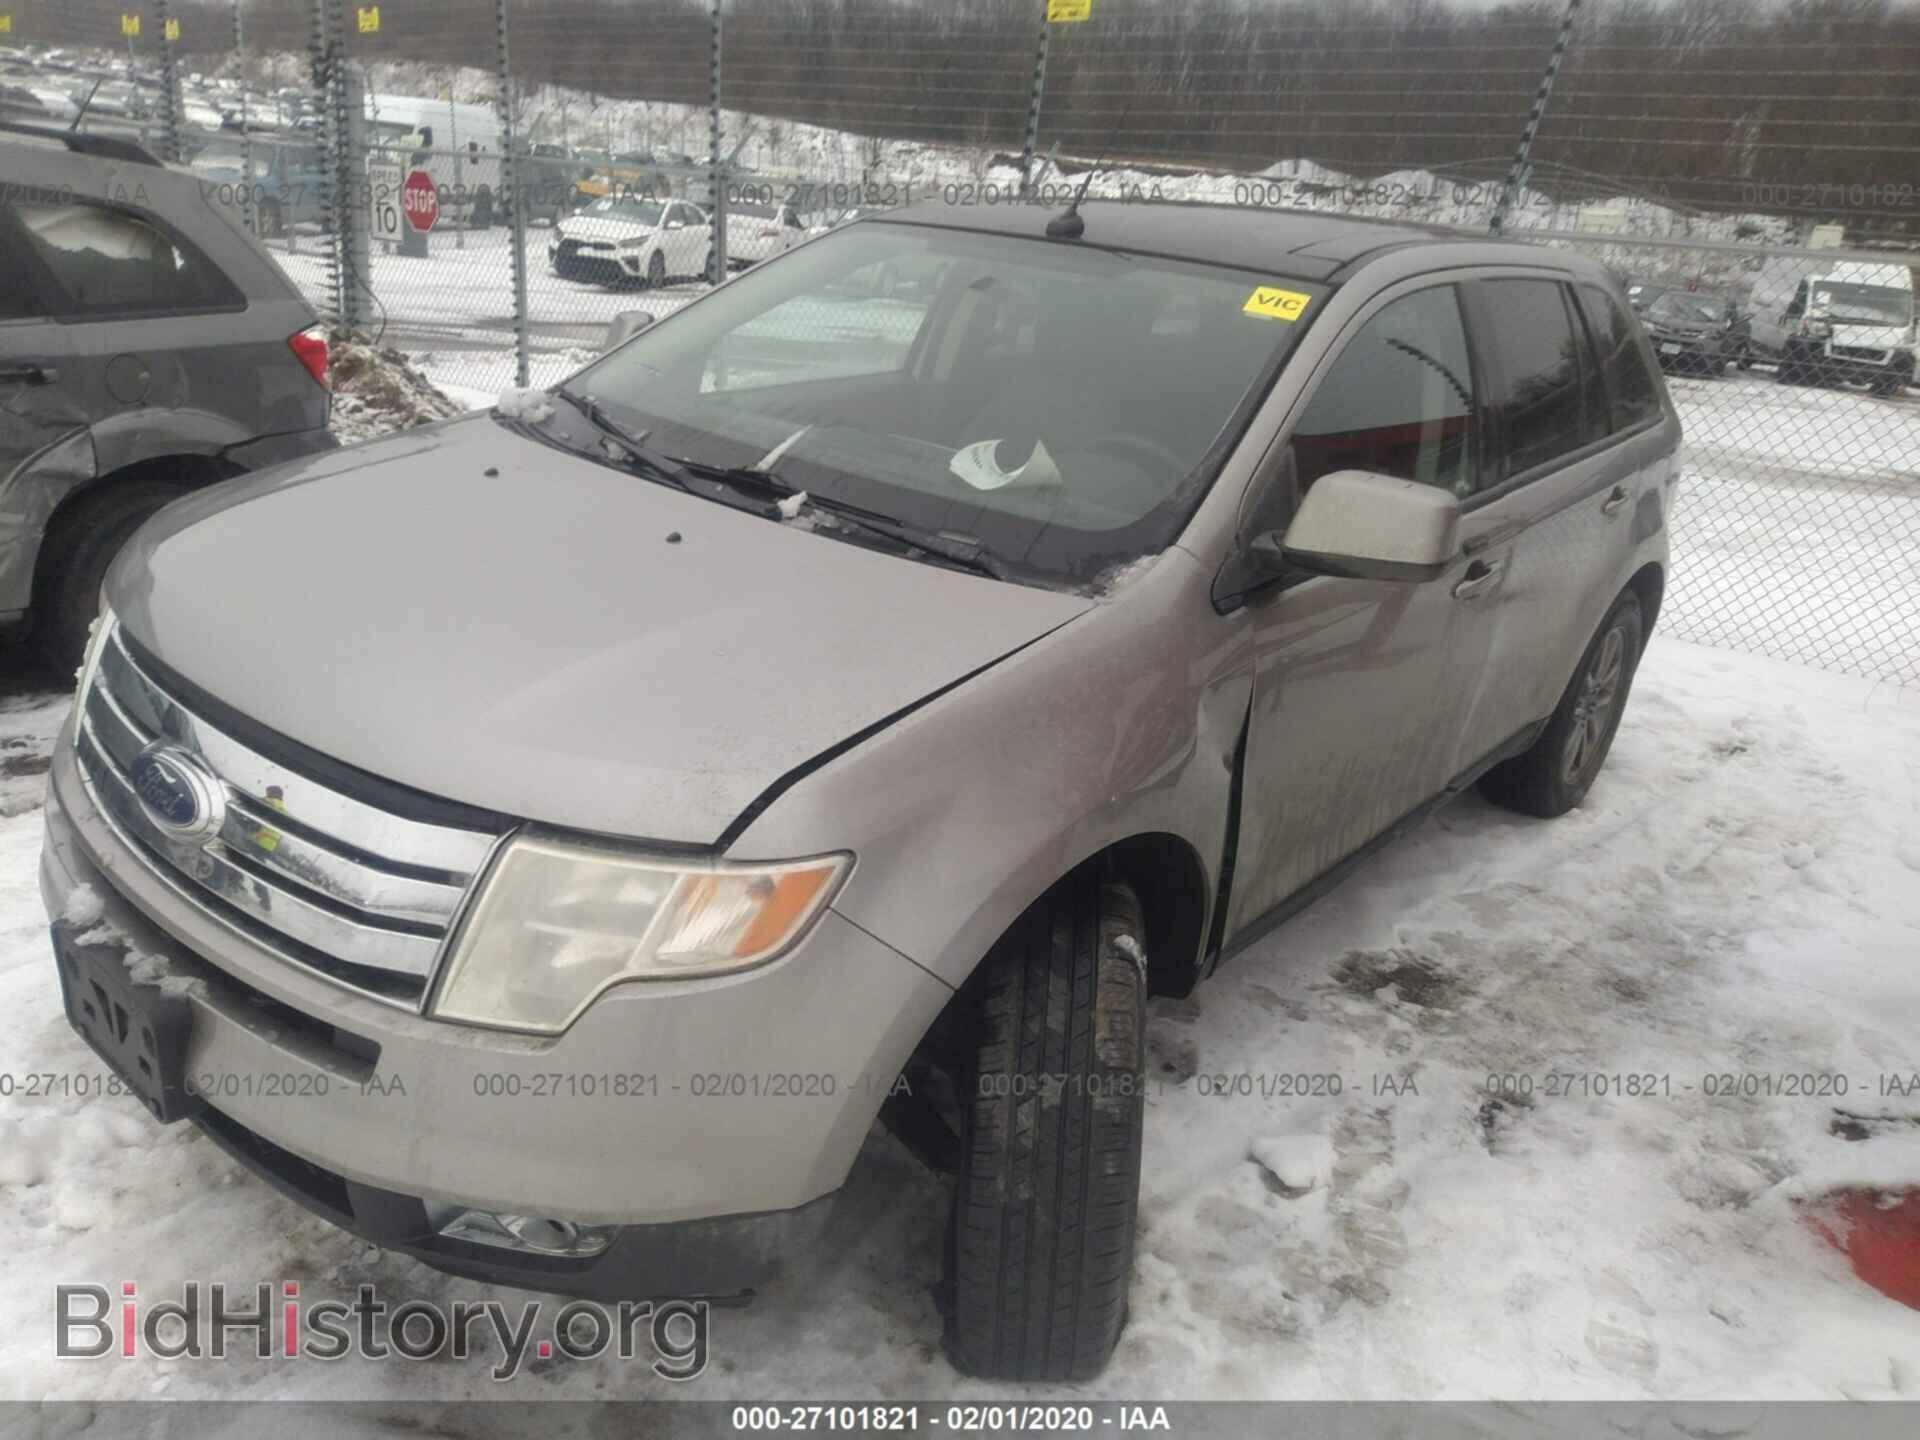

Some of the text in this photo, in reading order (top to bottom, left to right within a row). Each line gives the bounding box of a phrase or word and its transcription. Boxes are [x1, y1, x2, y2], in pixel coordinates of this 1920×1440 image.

[406, 188, 437, 213] STOP
[376, 206, 397, 233] 10
[1258, 293, 1302, 311] VIC
